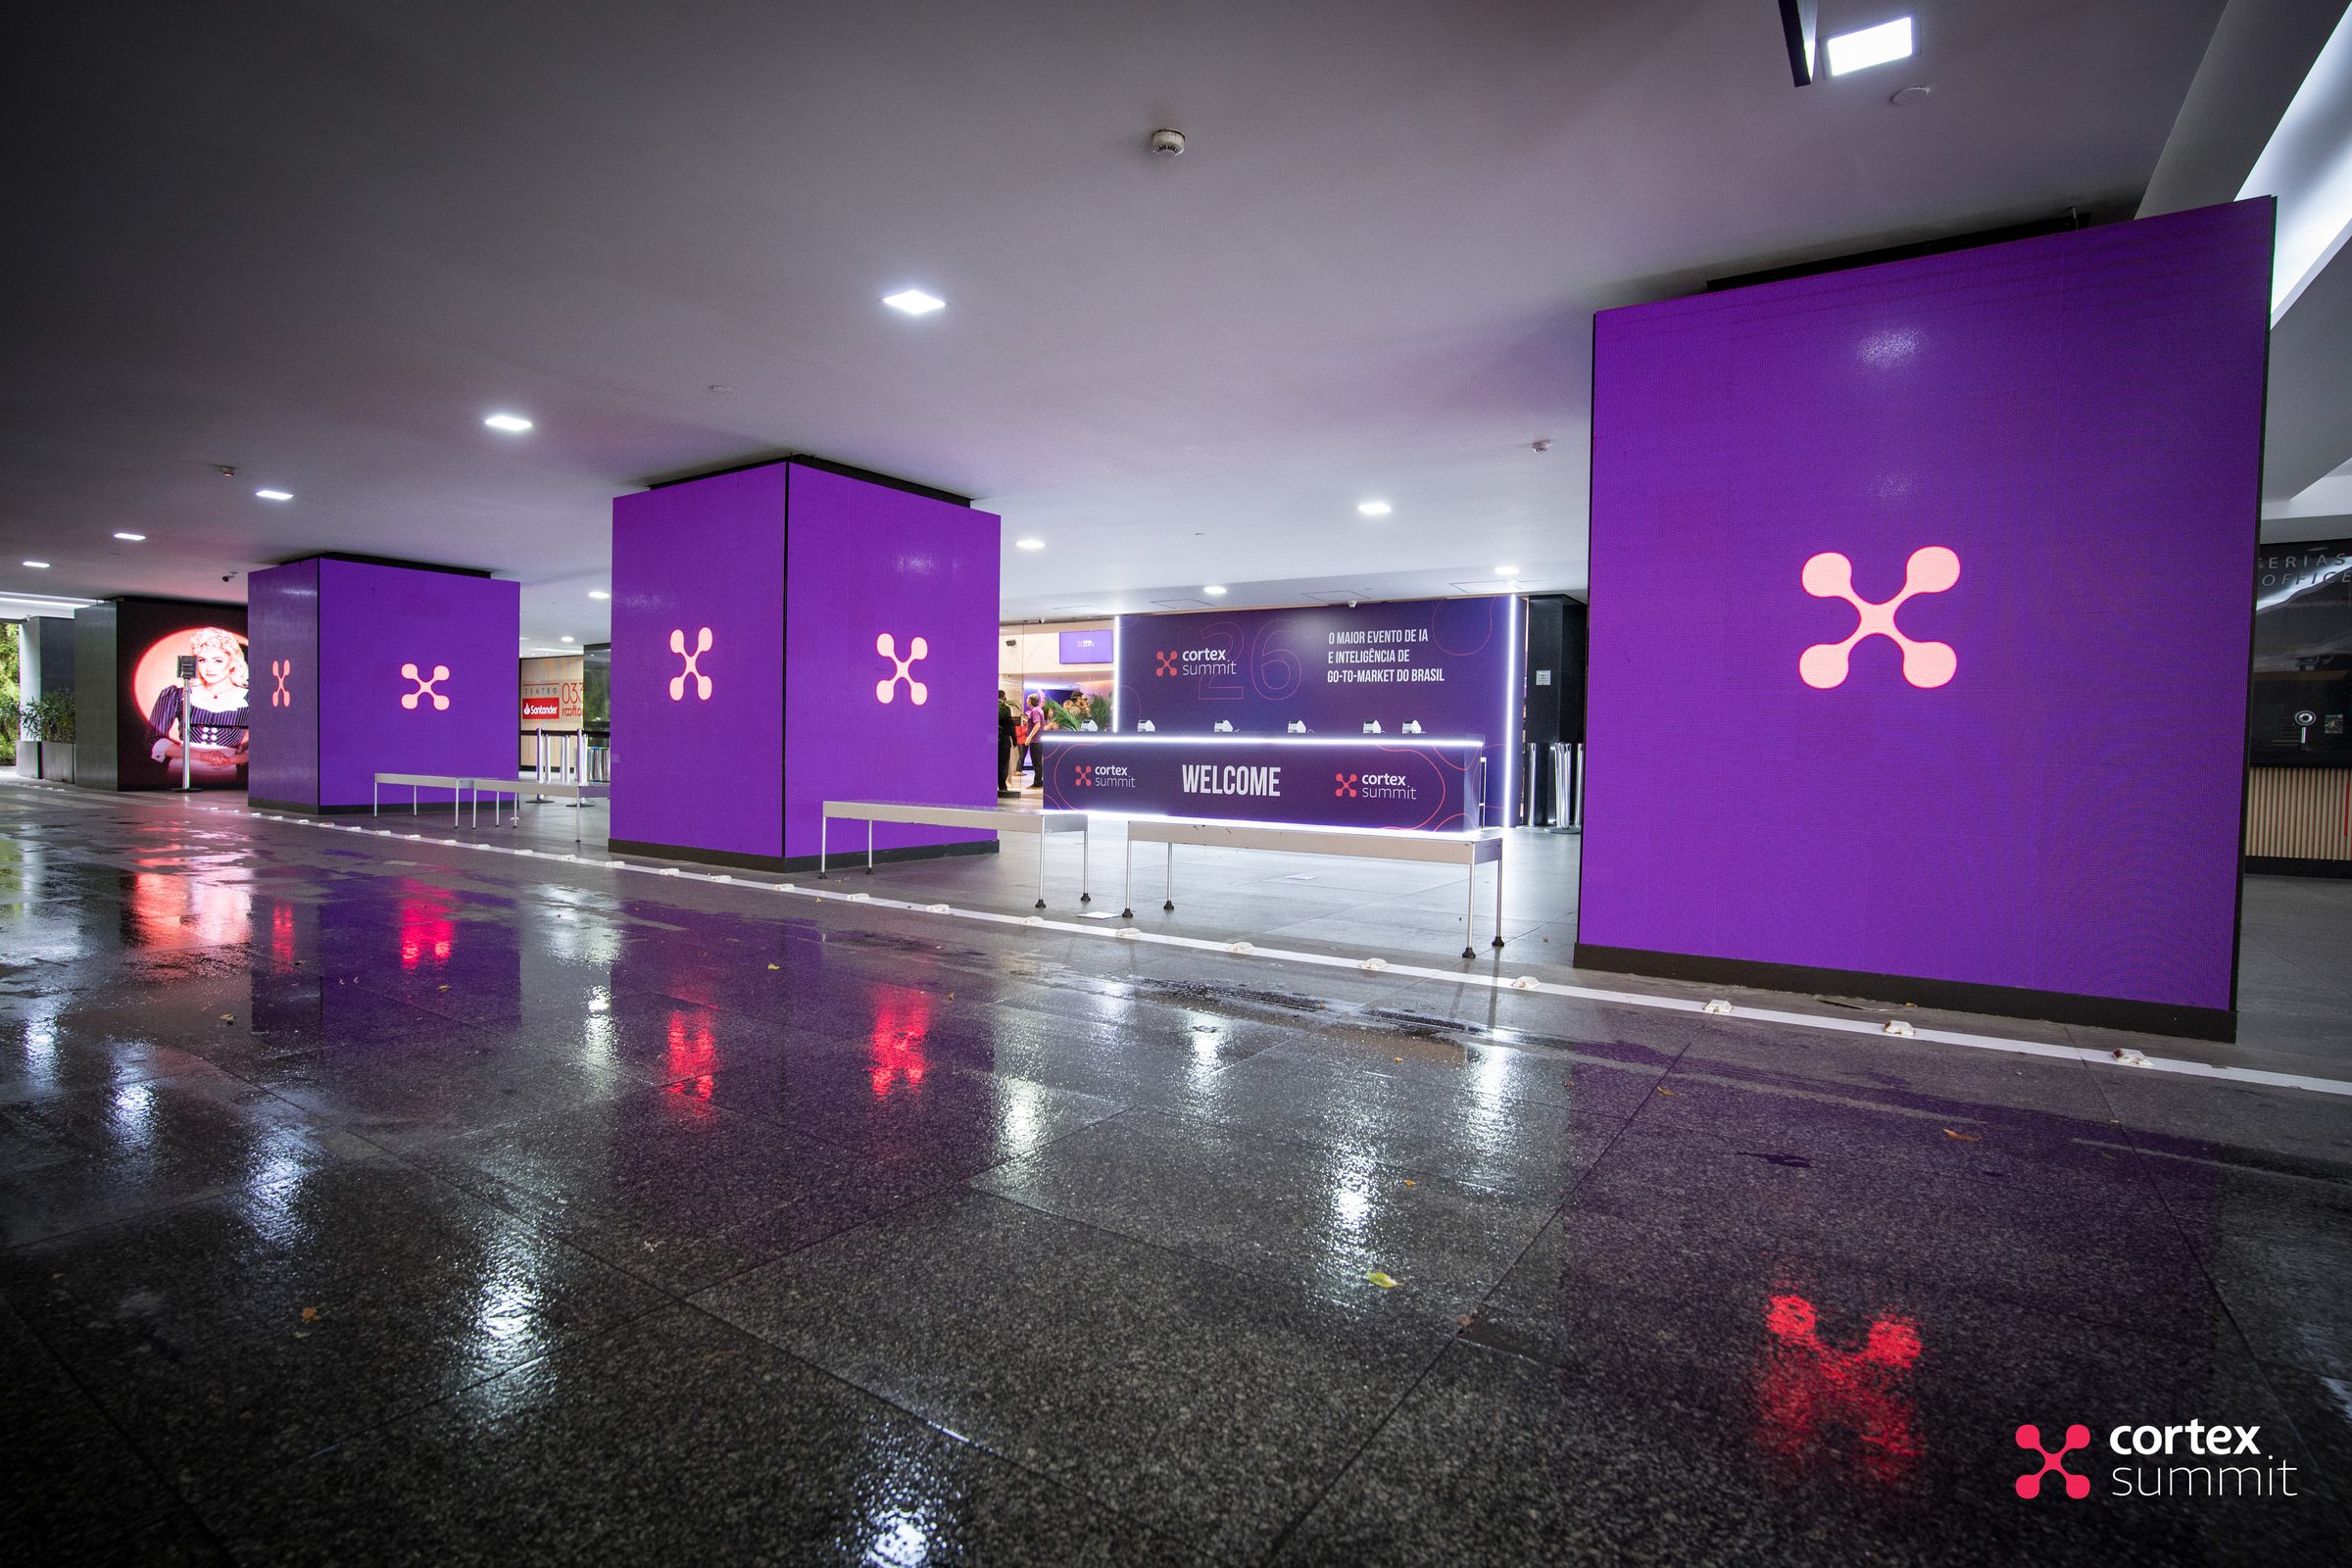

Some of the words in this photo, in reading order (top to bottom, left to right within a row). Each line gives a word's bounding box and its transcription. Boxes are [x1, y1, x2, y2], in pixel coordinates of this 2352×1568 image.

[2262, 570, 2352, 587] OFFICE
[1328, 632, 1335, 645] O
[1337, 631, 1365, 644] MAIOR
[1367, 630, 1402, 644] EVENTO
[1404, 629, 1417, 642] DE
[1418, 628, 1429, 642] IA
[1182, 648, 1227, 662] cortex
[1198, 618, 1302, 701] 26
[1328, 651, 1334, 663] E
[1336, 648, 1396, 663] INTELIGÊNCIA
[1397, 649, 1410, 662] DE
[1182, 660, 1237, 676] summit
[1327, 669, 1395, 683] GO-TO-MARKET
[1396, 669, 1409, 681] DO
[1411, 668, 1446, 682] BRASIL
[530, 706, 558, 715] Santander
[563, 706, 584, 716] roofto
[1095, 764, 1128, 776] cortex
[1095, 775, 1136, 788] summit
[1182, 764, 1282, 797] WELCOME
[1361, 772, 1406, 786] cortex
[1361, 785, 1417, 800] summit
